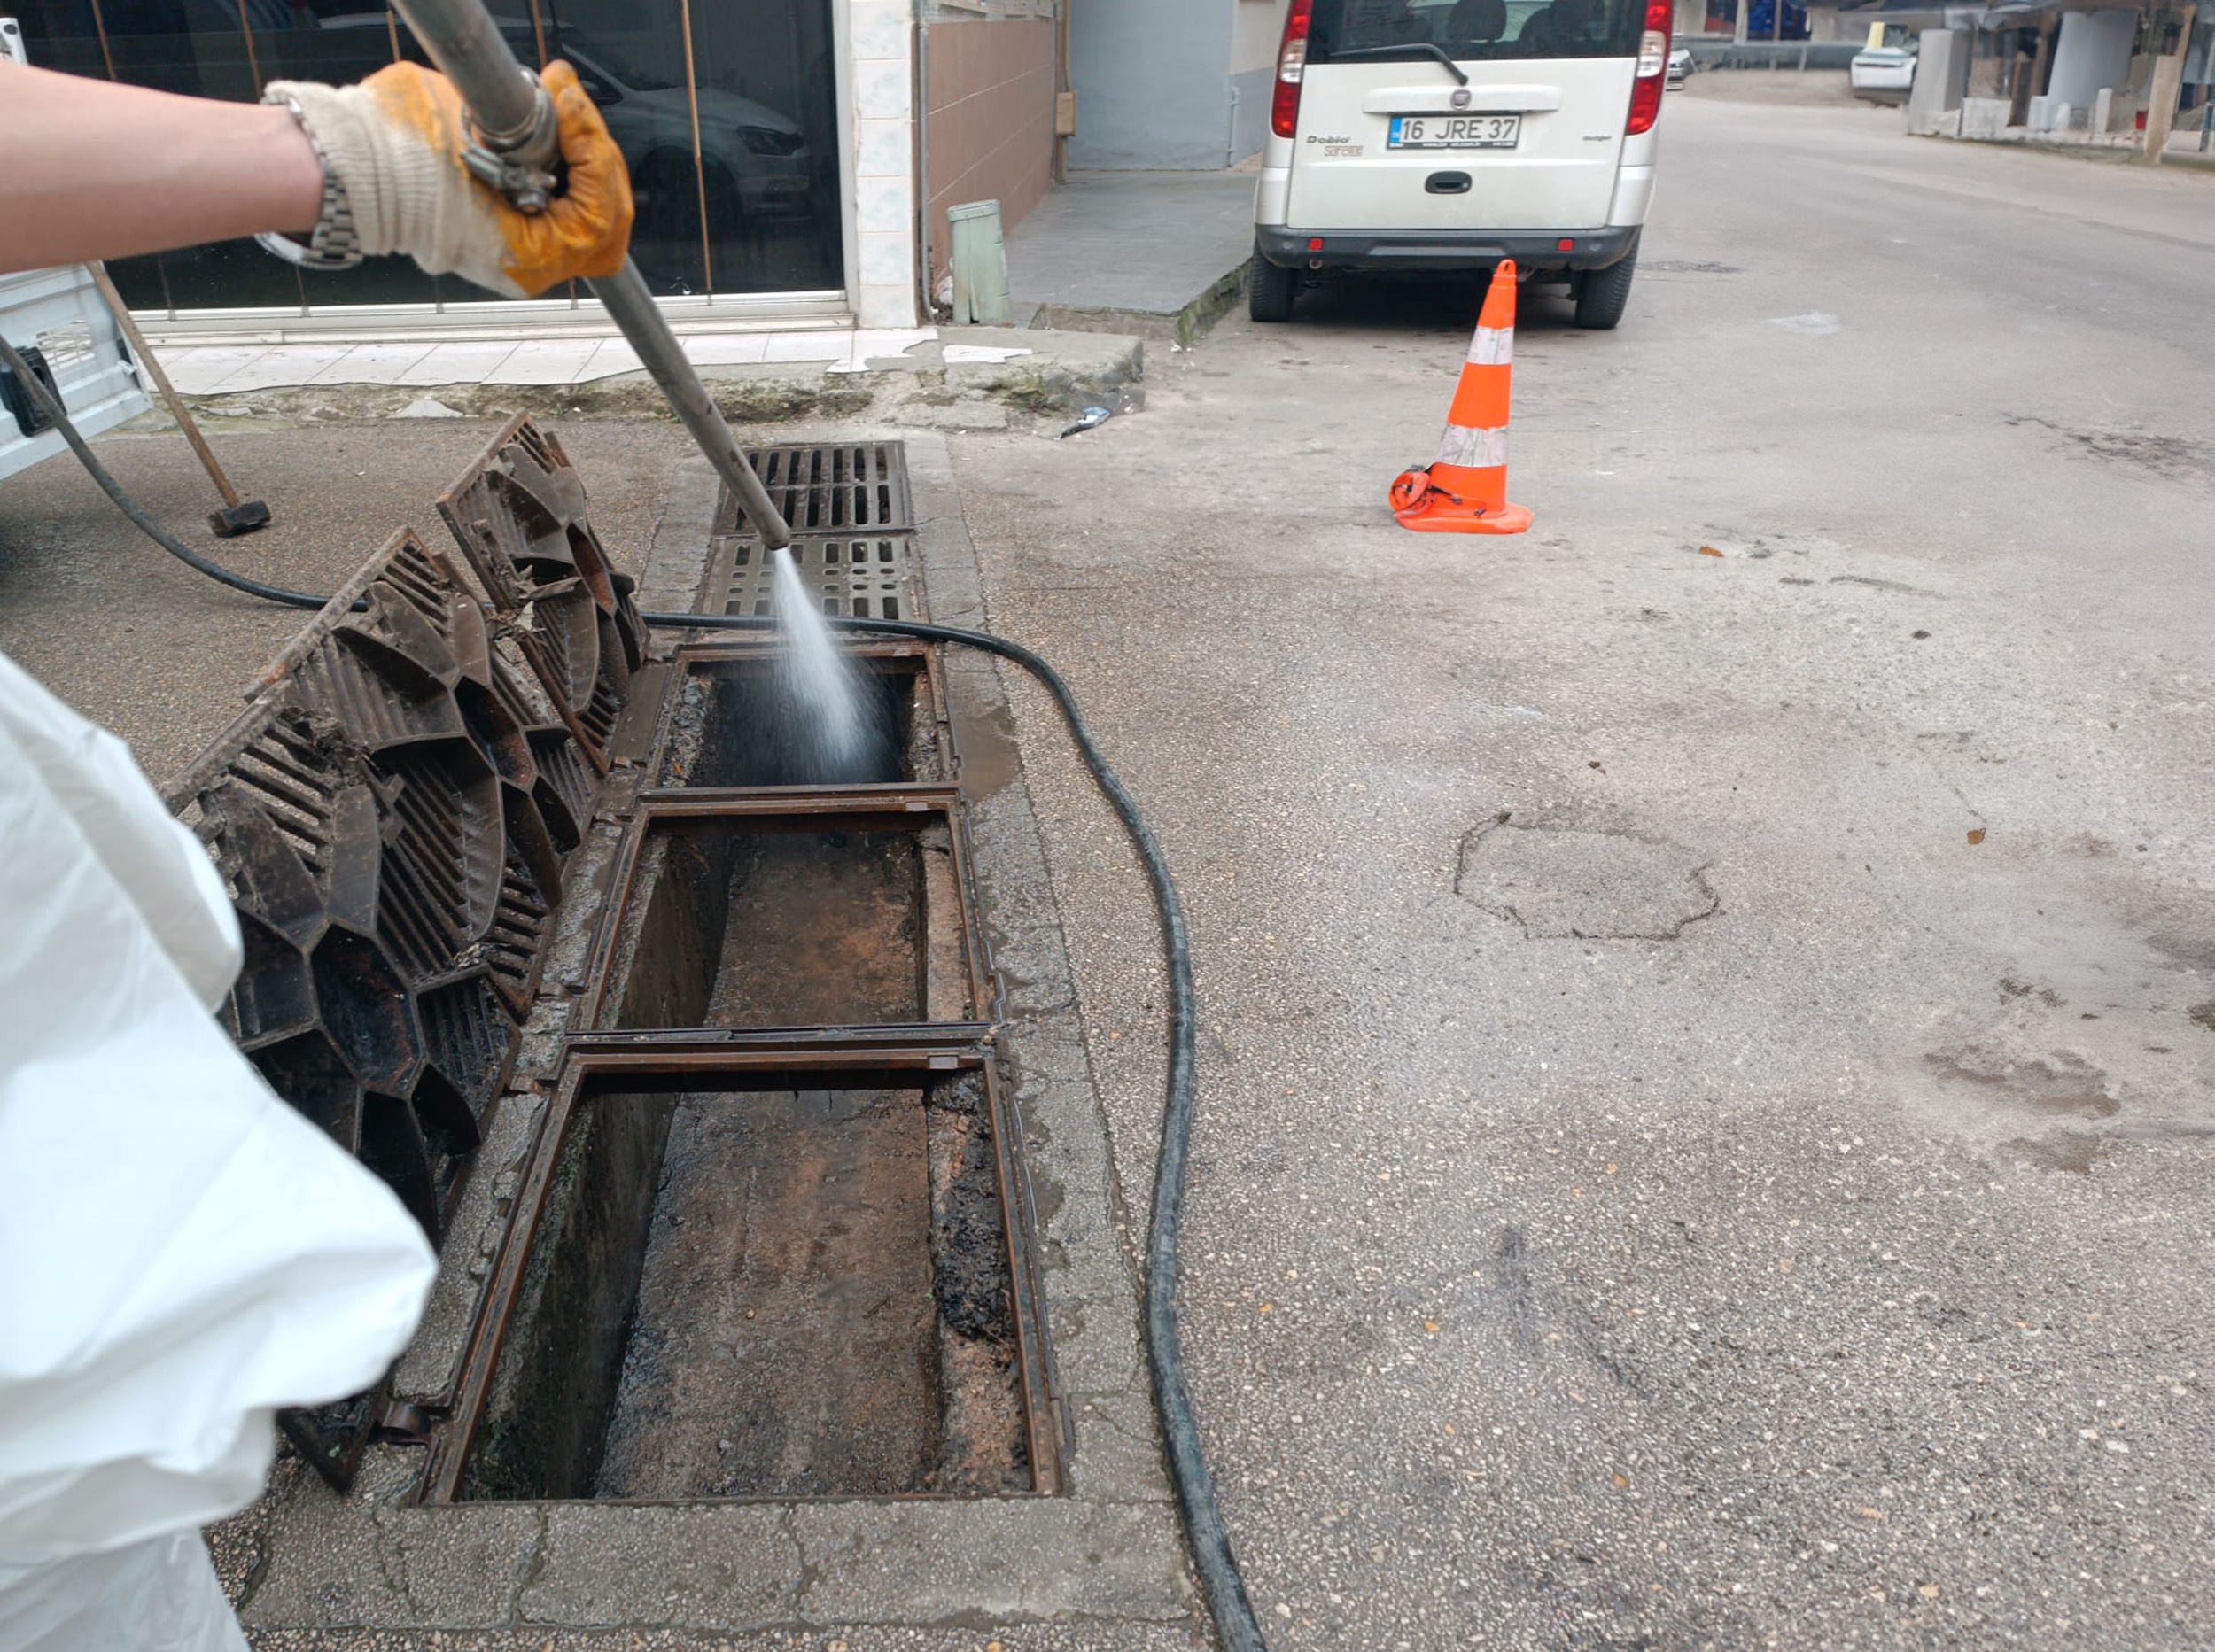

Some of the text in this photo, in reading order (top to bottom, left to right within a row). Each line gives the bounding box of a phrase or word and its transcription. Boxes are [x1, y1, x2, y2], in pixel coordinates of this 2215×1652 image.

[1403, 120, 1424, 140] 16
[1435, 120, 1484, 139] JRE
[1488, 119, 1516, 139] 37
